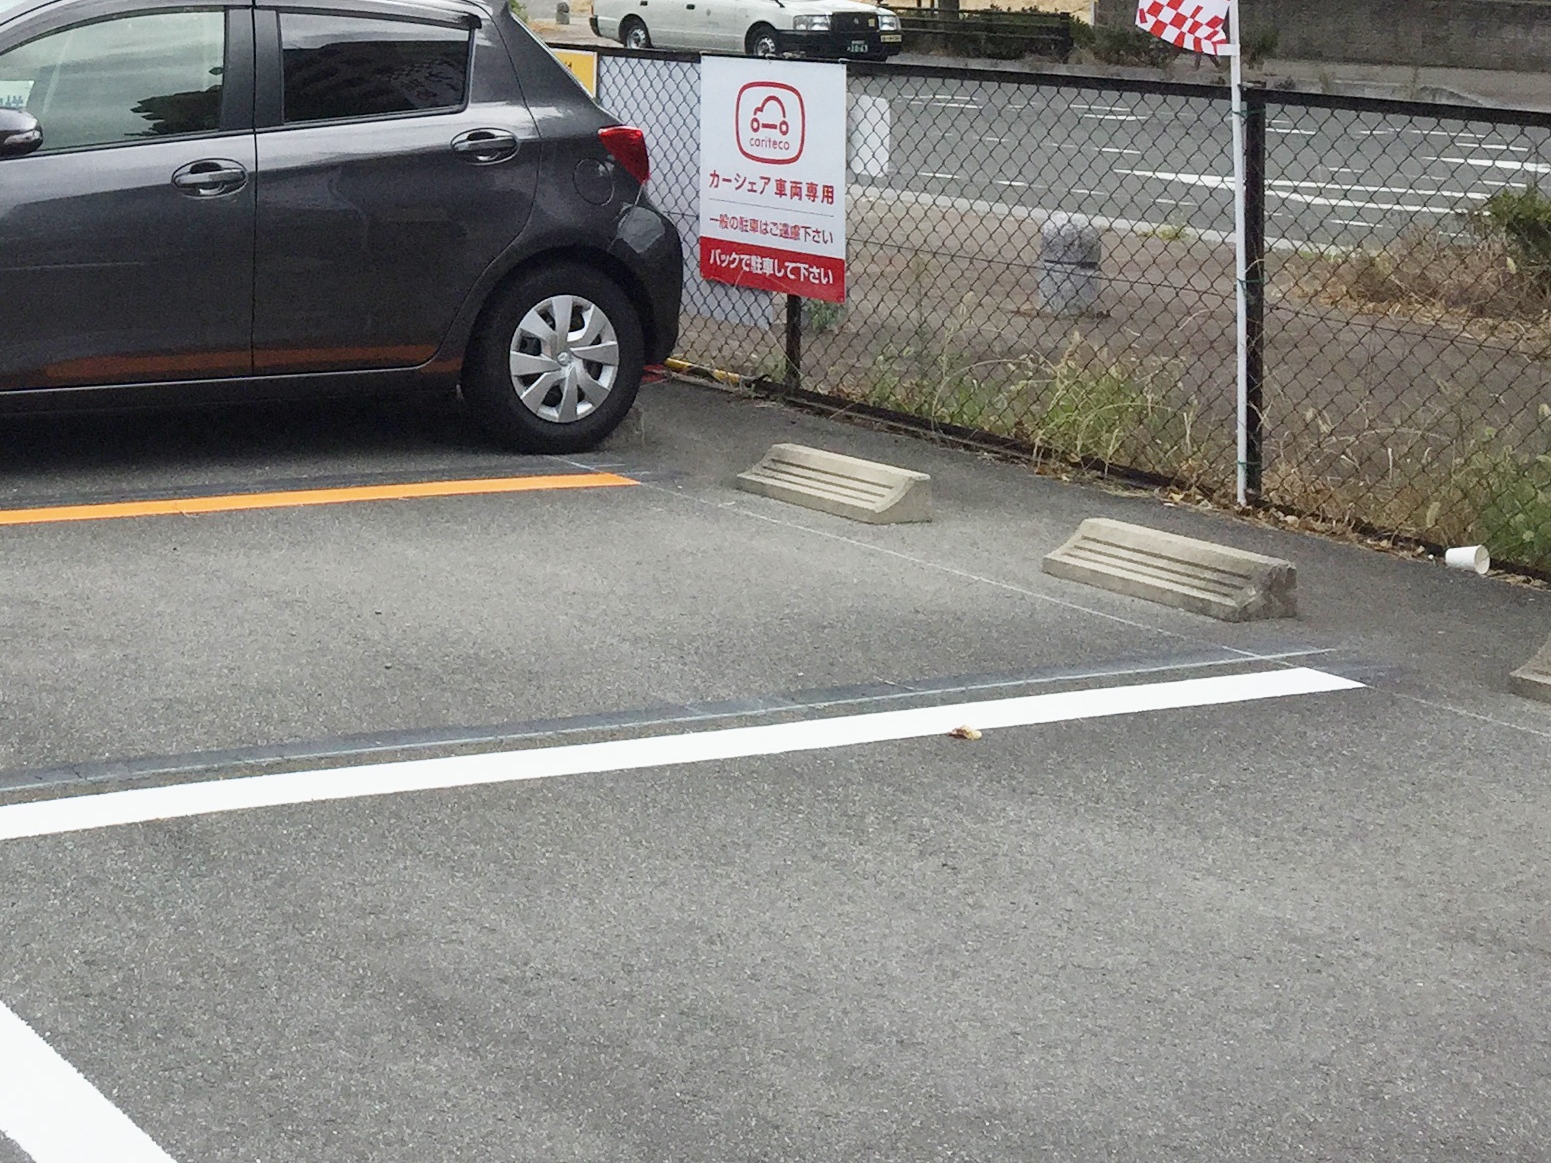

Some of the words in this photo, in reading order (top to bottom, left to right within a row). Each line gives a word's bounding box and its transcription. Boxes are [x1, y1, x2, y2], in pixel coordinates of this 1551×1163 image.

[709, 214, 834, 244] 一般の駐車はご遠慮下さい
[709, 249, 834, 284] バックで駐車して下さい
